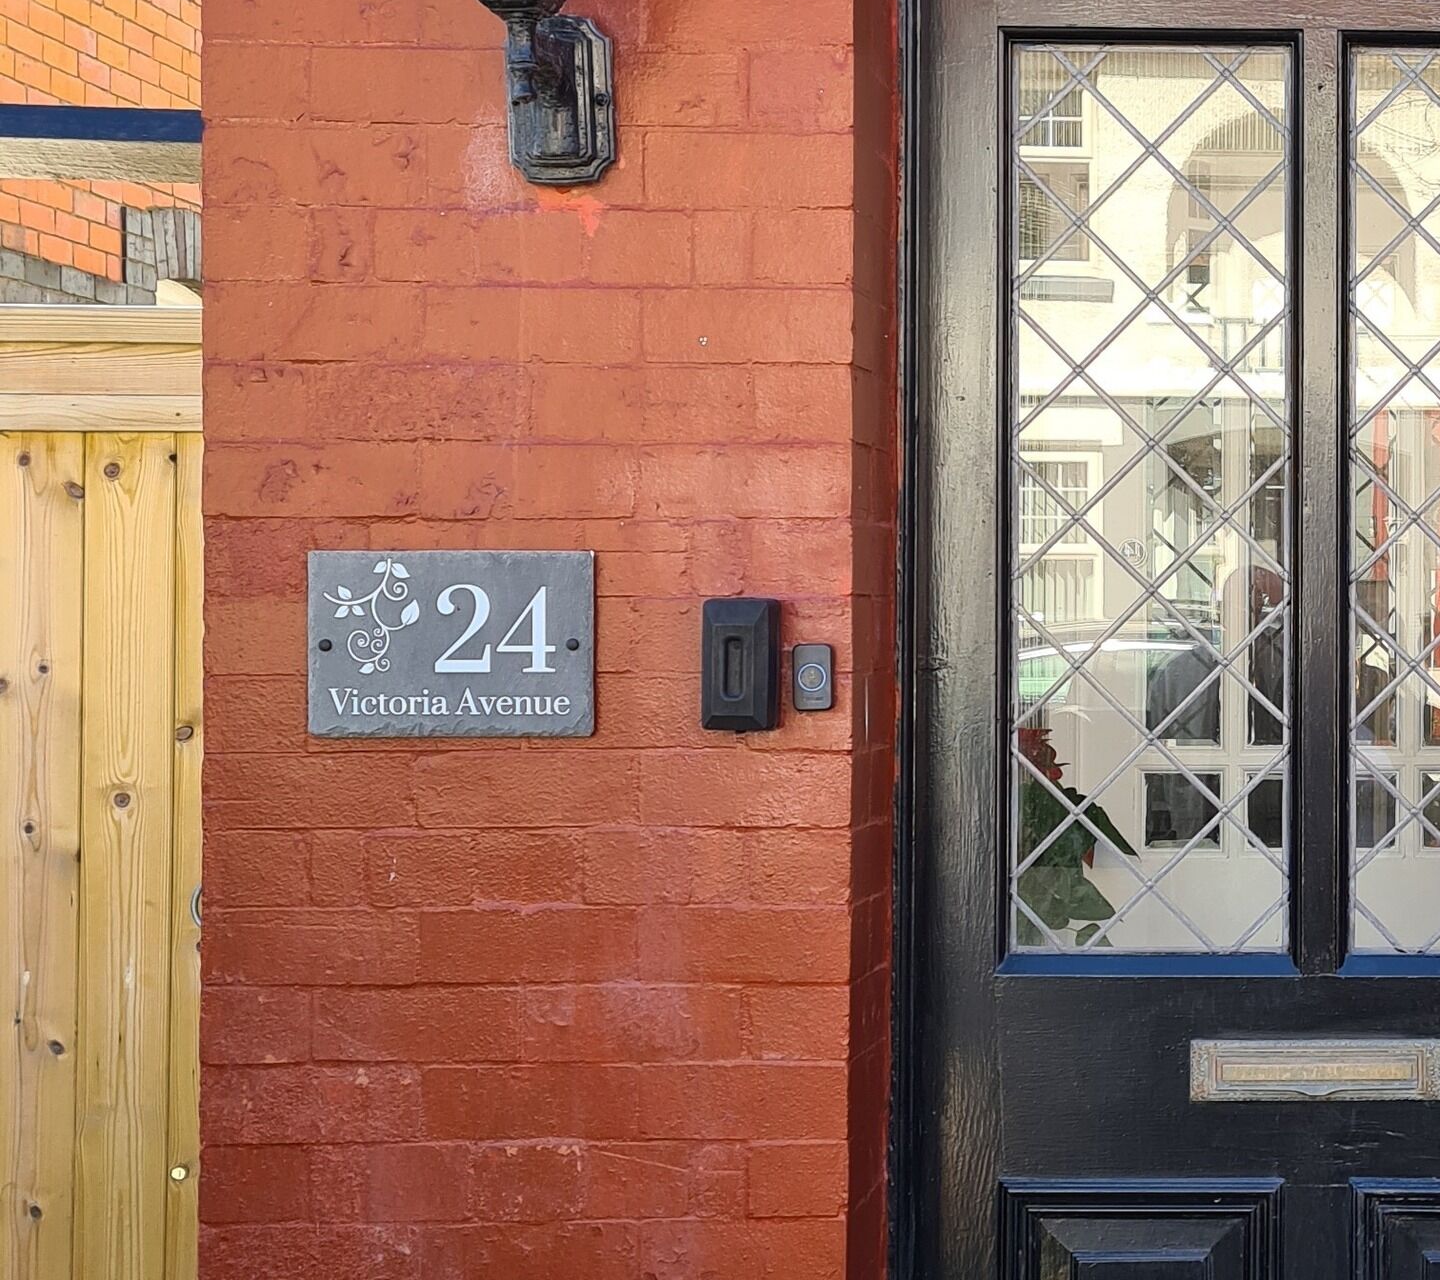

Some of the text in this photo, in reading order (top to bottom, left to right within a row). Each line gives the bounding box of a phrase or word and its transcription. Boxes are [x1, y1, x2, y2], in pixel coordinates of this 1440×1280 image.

[434, 583, 556, 673] 24
[328, 687, 571, 716] Victoria Avenue
